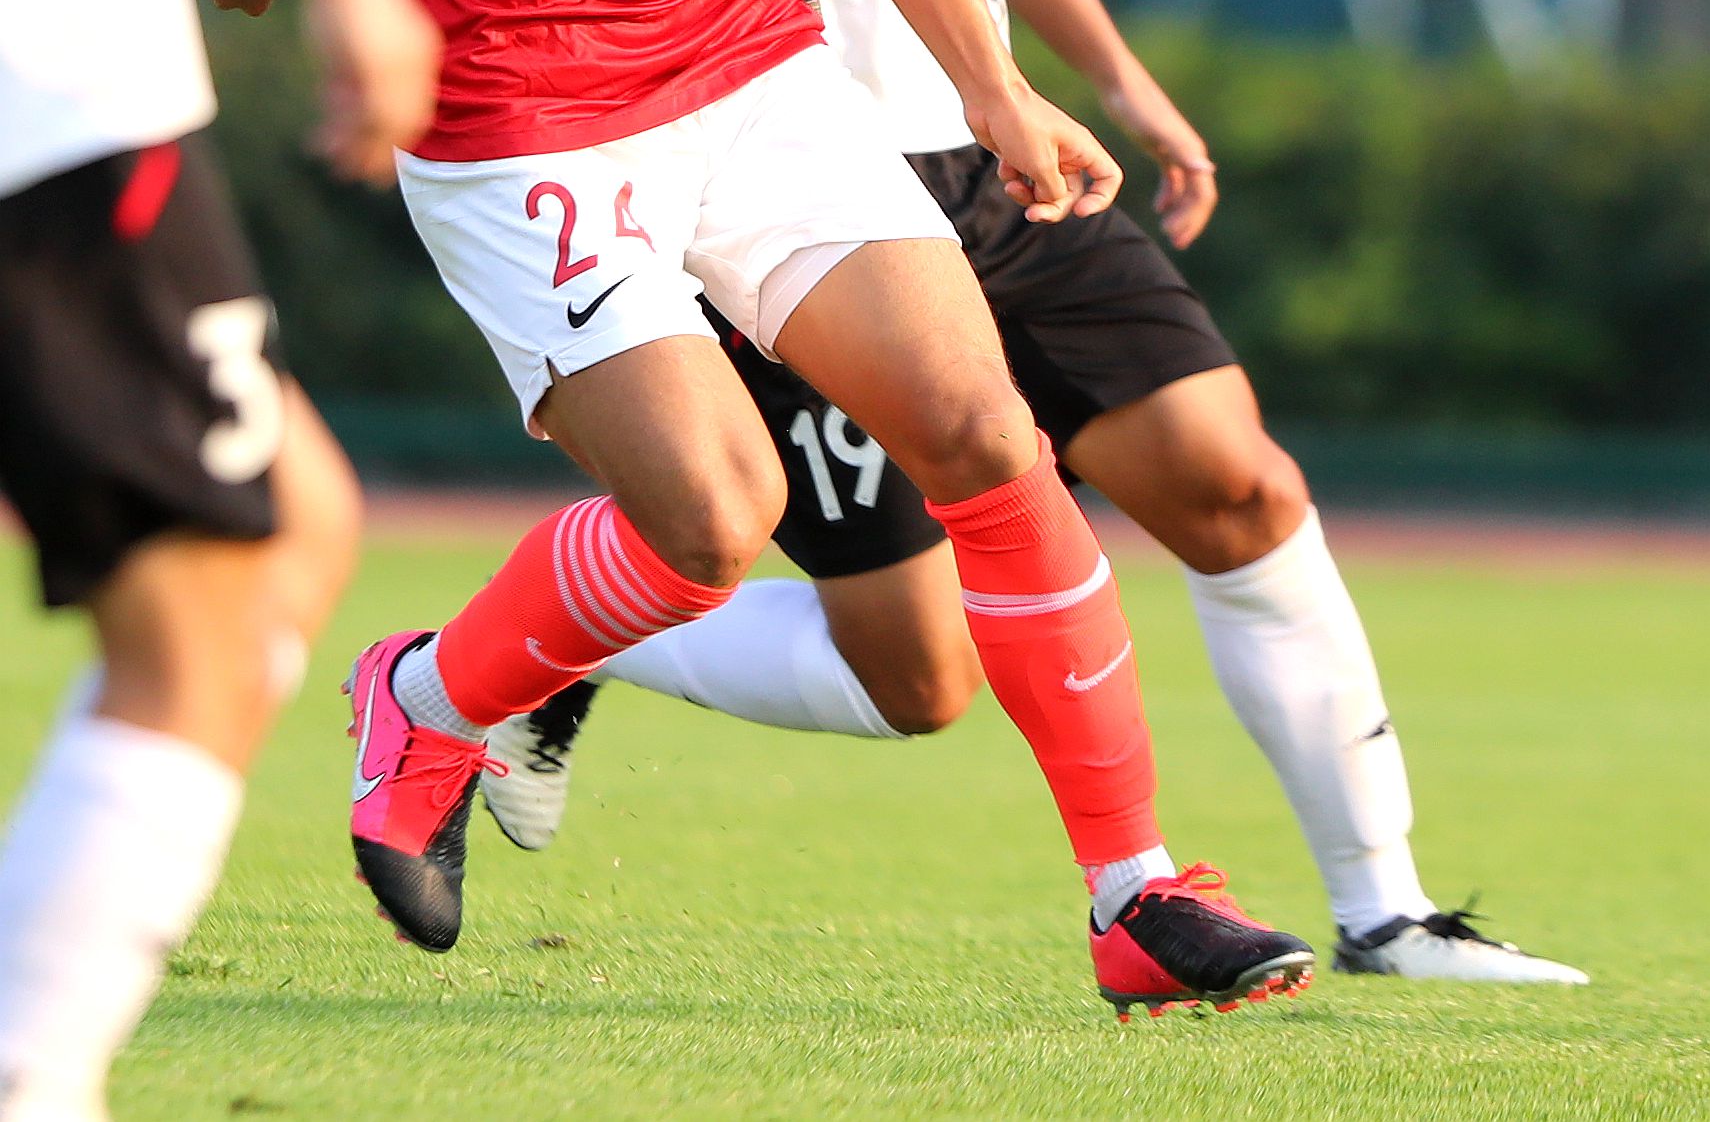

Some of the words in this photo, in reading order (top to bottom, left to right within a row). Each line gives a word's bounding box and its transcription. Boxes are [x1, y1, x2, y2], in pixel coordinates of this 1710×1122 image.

[526, 181, 657, 289] 24
[185, 295, 282, 484] 3
[789, 404, 887, 522] 19
